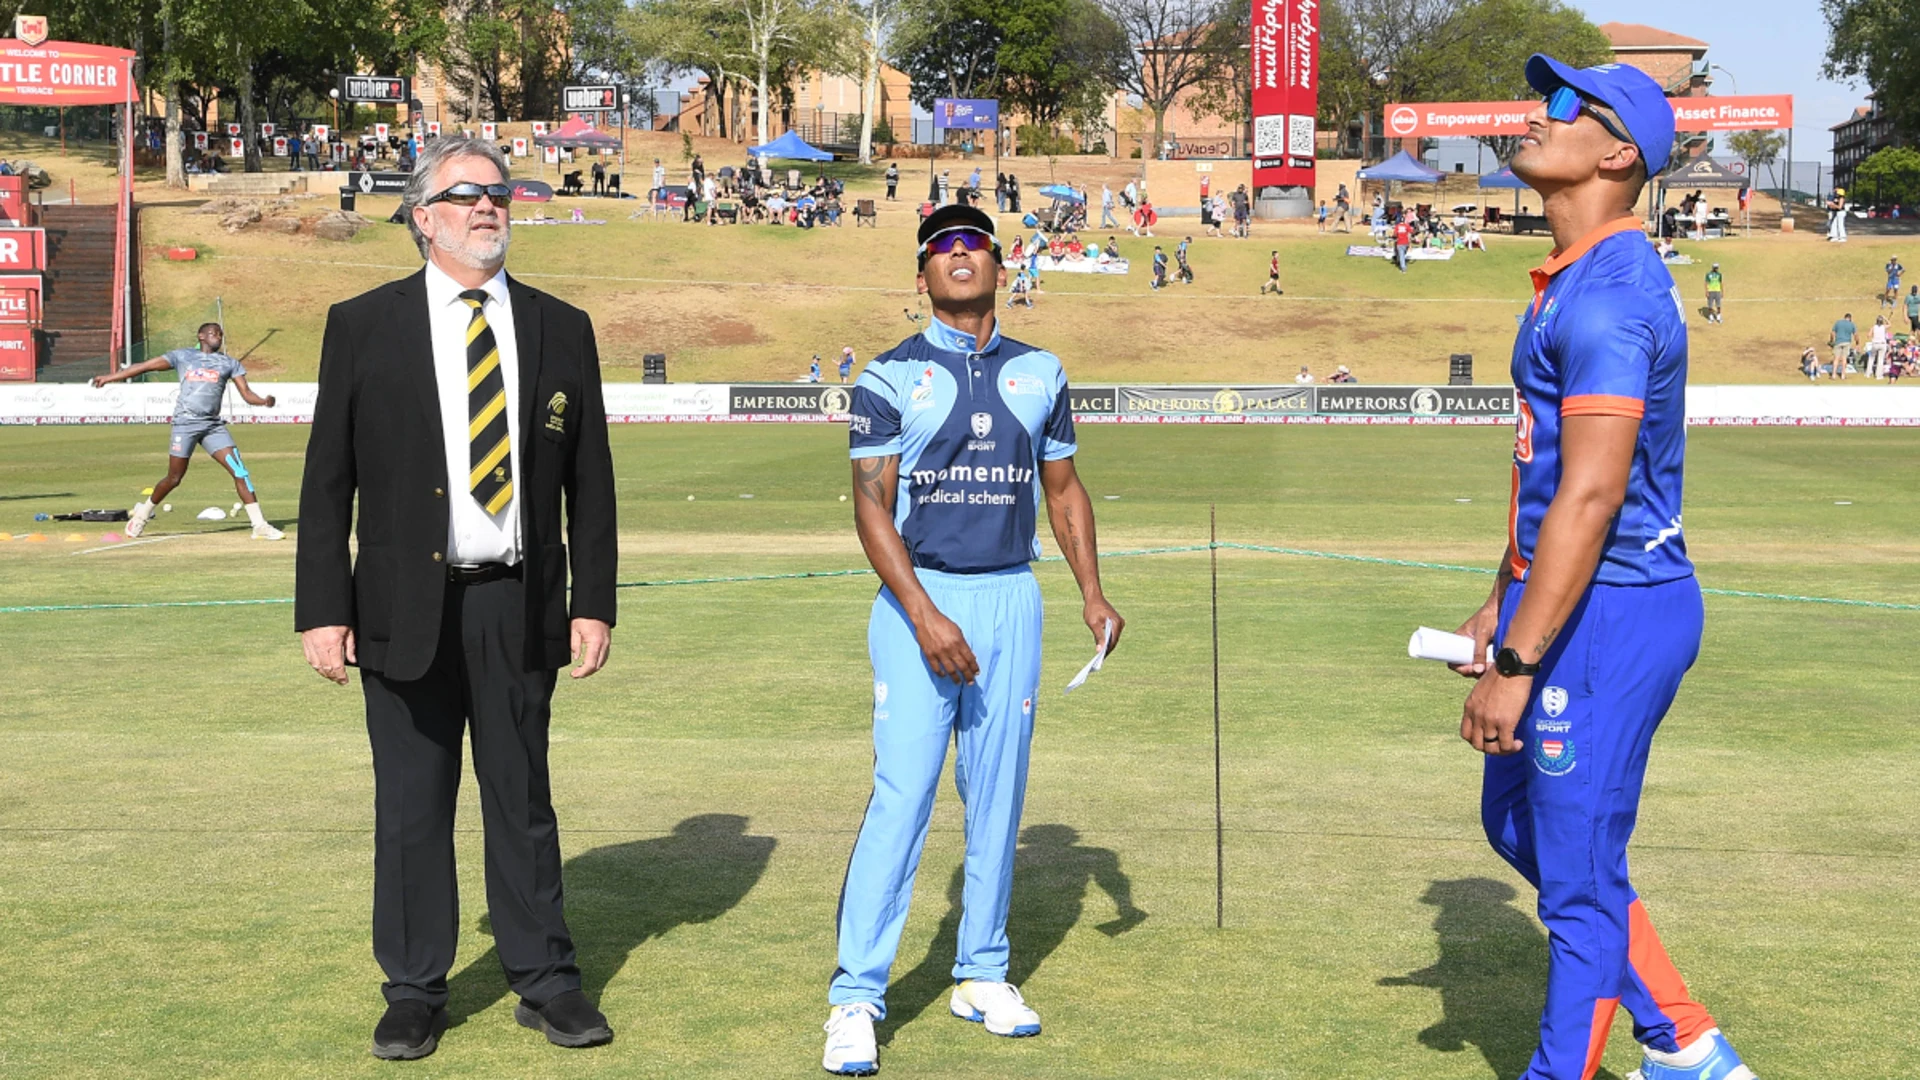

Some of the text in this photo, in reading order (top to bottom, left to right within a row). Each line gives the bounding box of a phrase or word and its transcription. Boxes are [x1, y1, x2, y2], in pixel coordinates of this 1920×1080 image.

[6, 49, 59, 58] WELCOME TO
[50, 63, 117, 86] CORNER
[15, 86, 54, 95] TERRACE
[351, 79, 390, 98] weber
[568, 88, 604, 107] weber
[1675, 105, 1780, 120] Asset Finance.
[1426, 112, 1526, 127] Empower your
[733, 396, 817, 408] EMPERORS
[1070, 398, 1112, 410] LACE
[1128, 397, 1308, 411] EMPERORS PALACE
[1321, 397, 1510, 410] EMPERORS PALACE
[1536, 724, 1571, 733] SPORT
